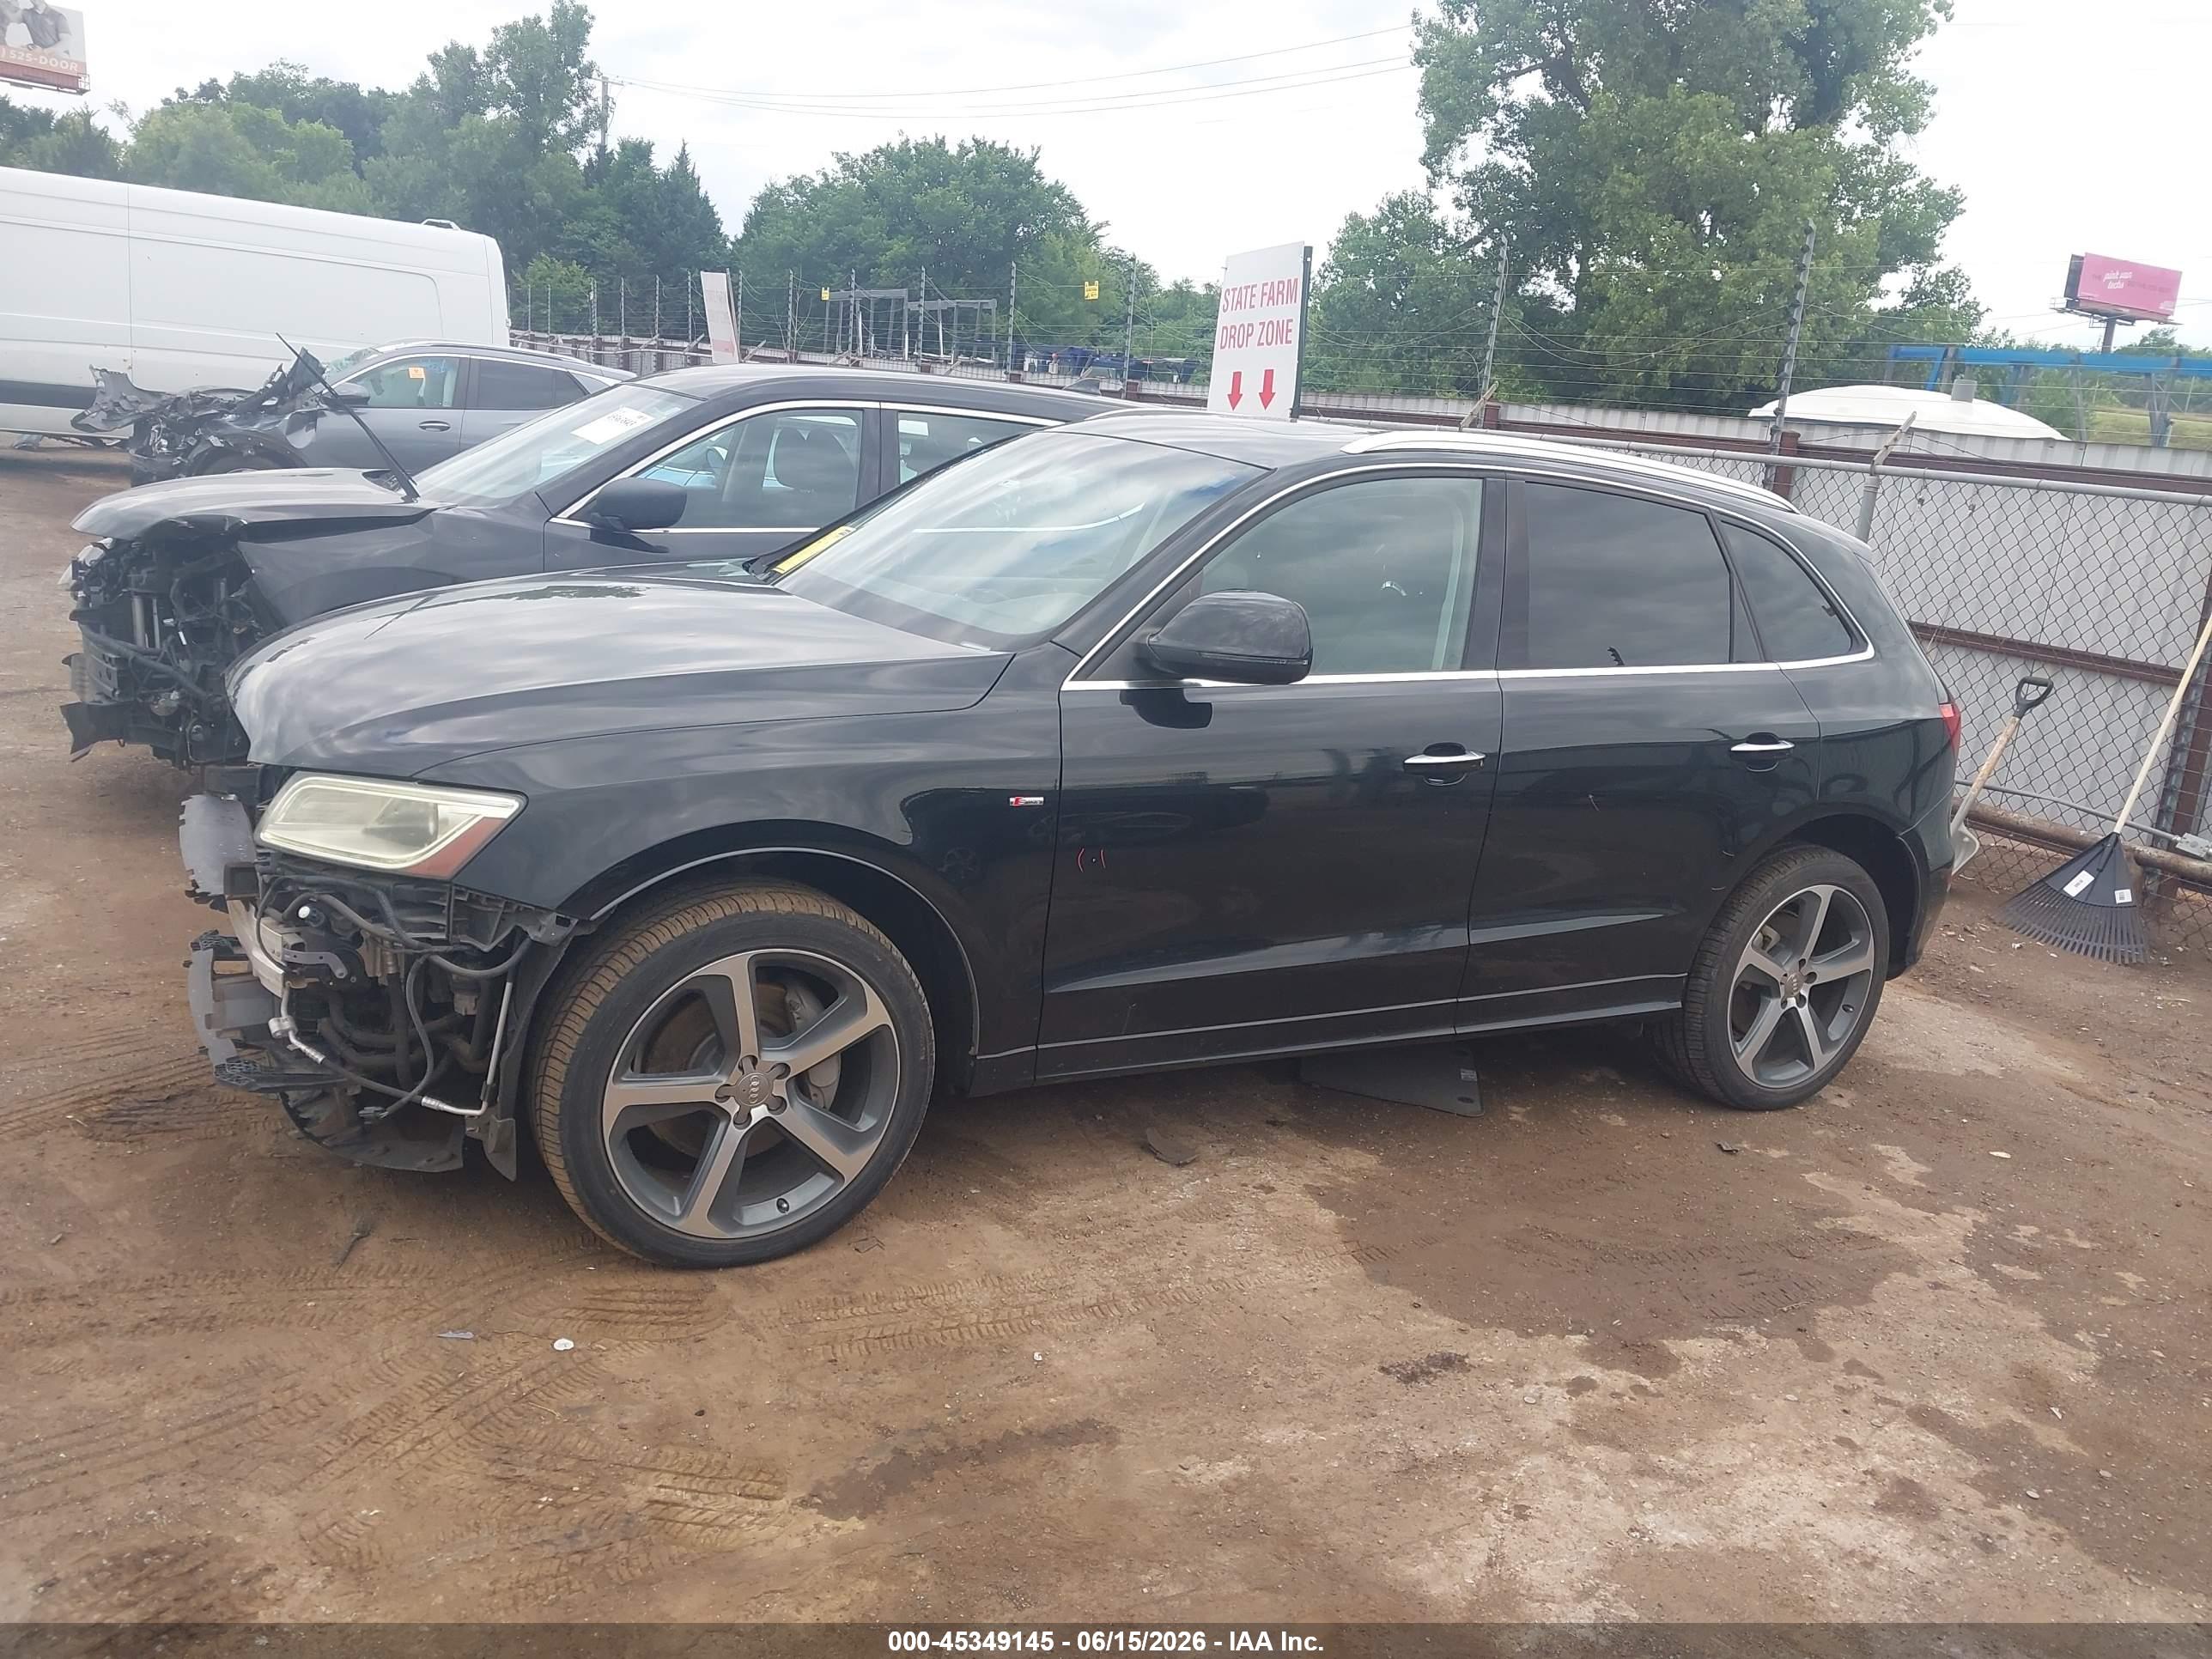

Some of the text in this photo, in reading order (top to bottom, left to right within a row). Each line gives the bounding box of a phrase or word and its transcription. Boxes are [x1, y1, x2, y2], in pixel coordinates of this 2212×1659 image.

[9, 49, 78, 71] 525-DOOR
[1223, 277, 1298, 313] STATE FARM
[1219, 319, 1293, 349] DROP ZONE
